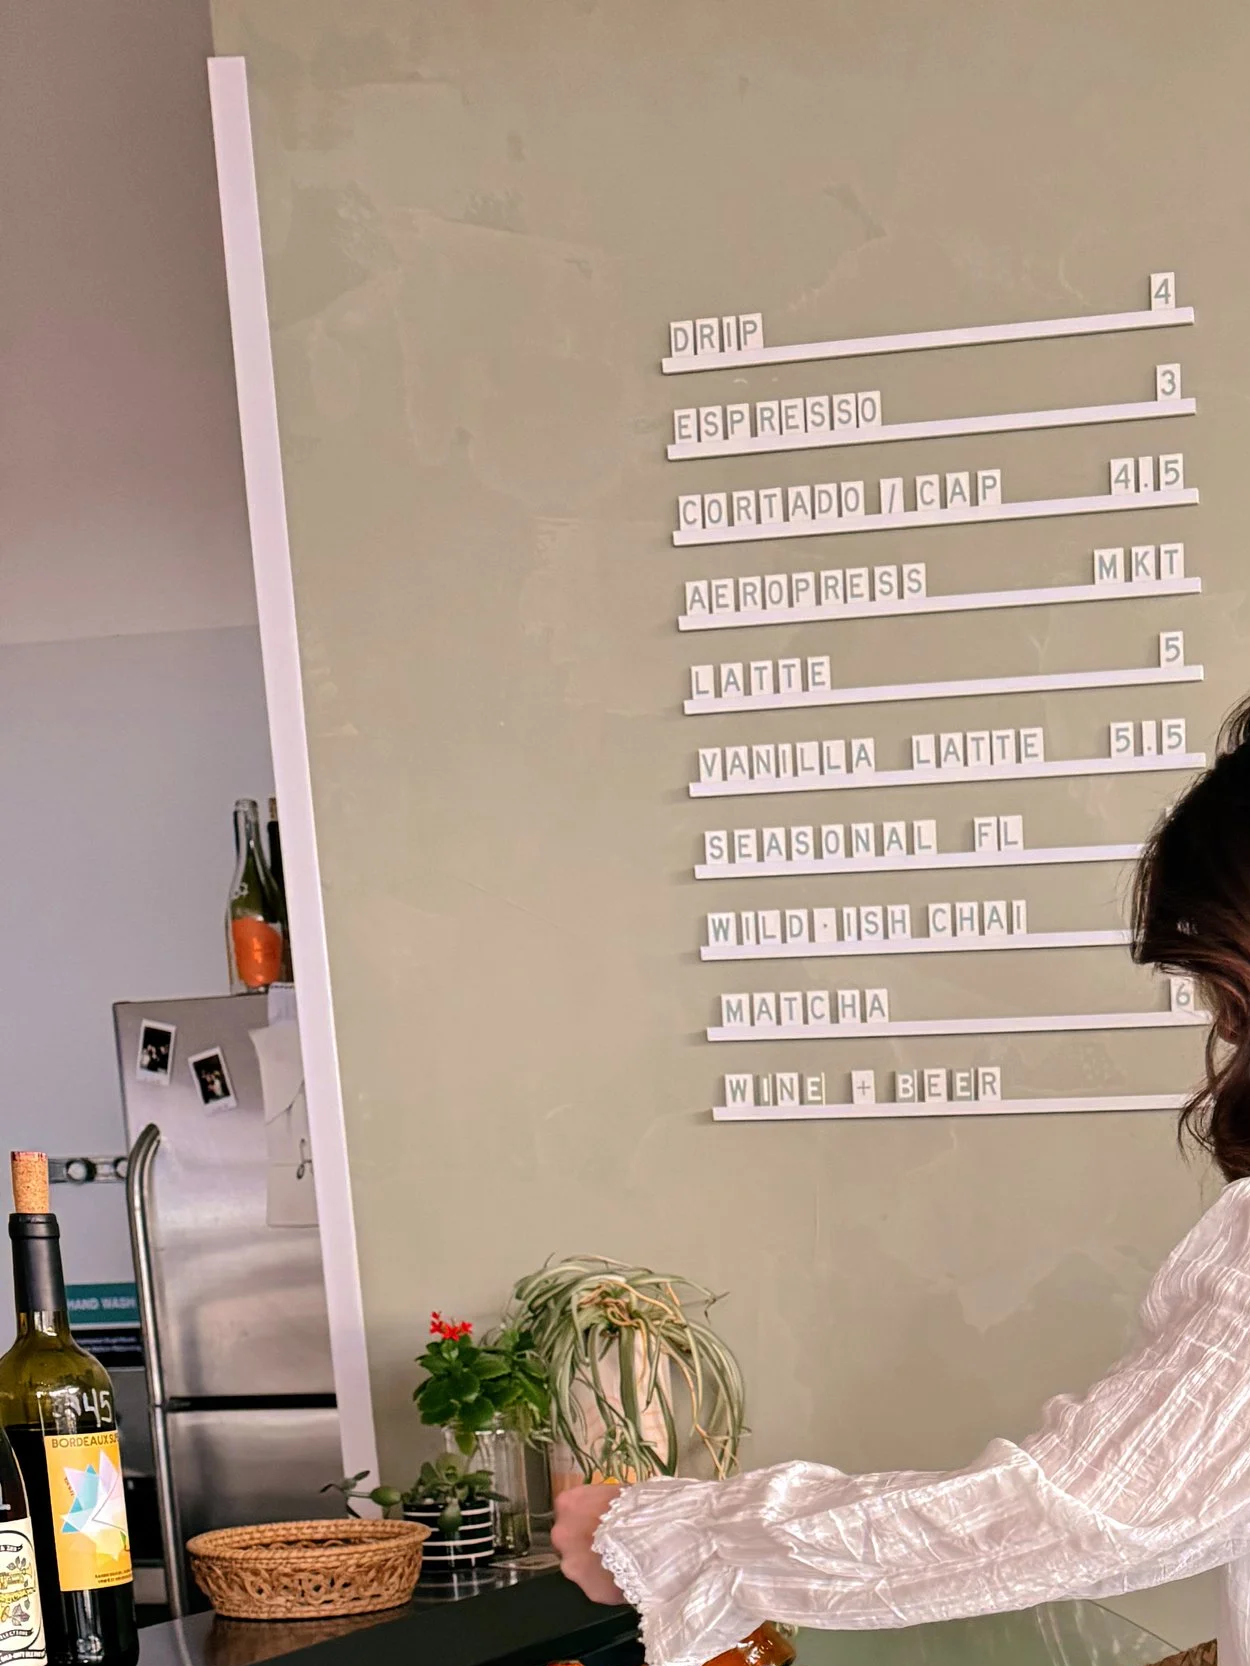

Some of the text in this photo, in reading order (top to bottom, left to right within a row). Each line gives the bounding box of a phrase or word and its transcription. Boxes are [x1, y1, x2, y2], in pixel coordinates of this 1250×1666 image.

[674, 277, 1172, 353] DRIP 4
[676, 368, 1177, 440] ESPRESSO 3
[1113, 458, 1181, 491] 4.5
[688, 549, 1180, 612] AEROPRESS MKT
[694, 636, 1181, 696] LATTE 5
[701, 723, 1183, 779] VANILLA LATTE 5.5
[708, 820, 1021, 861] SEASONAL FL
[931, 904, 1023, 934] CHAI
[724, 981, 1191, 1024] MATCHA 6
[728, 1075, 823, 1103] WINE
[898, 1071, 998, 1100] BEER
[51, 1434, 109, 1449] BORDEAUX
